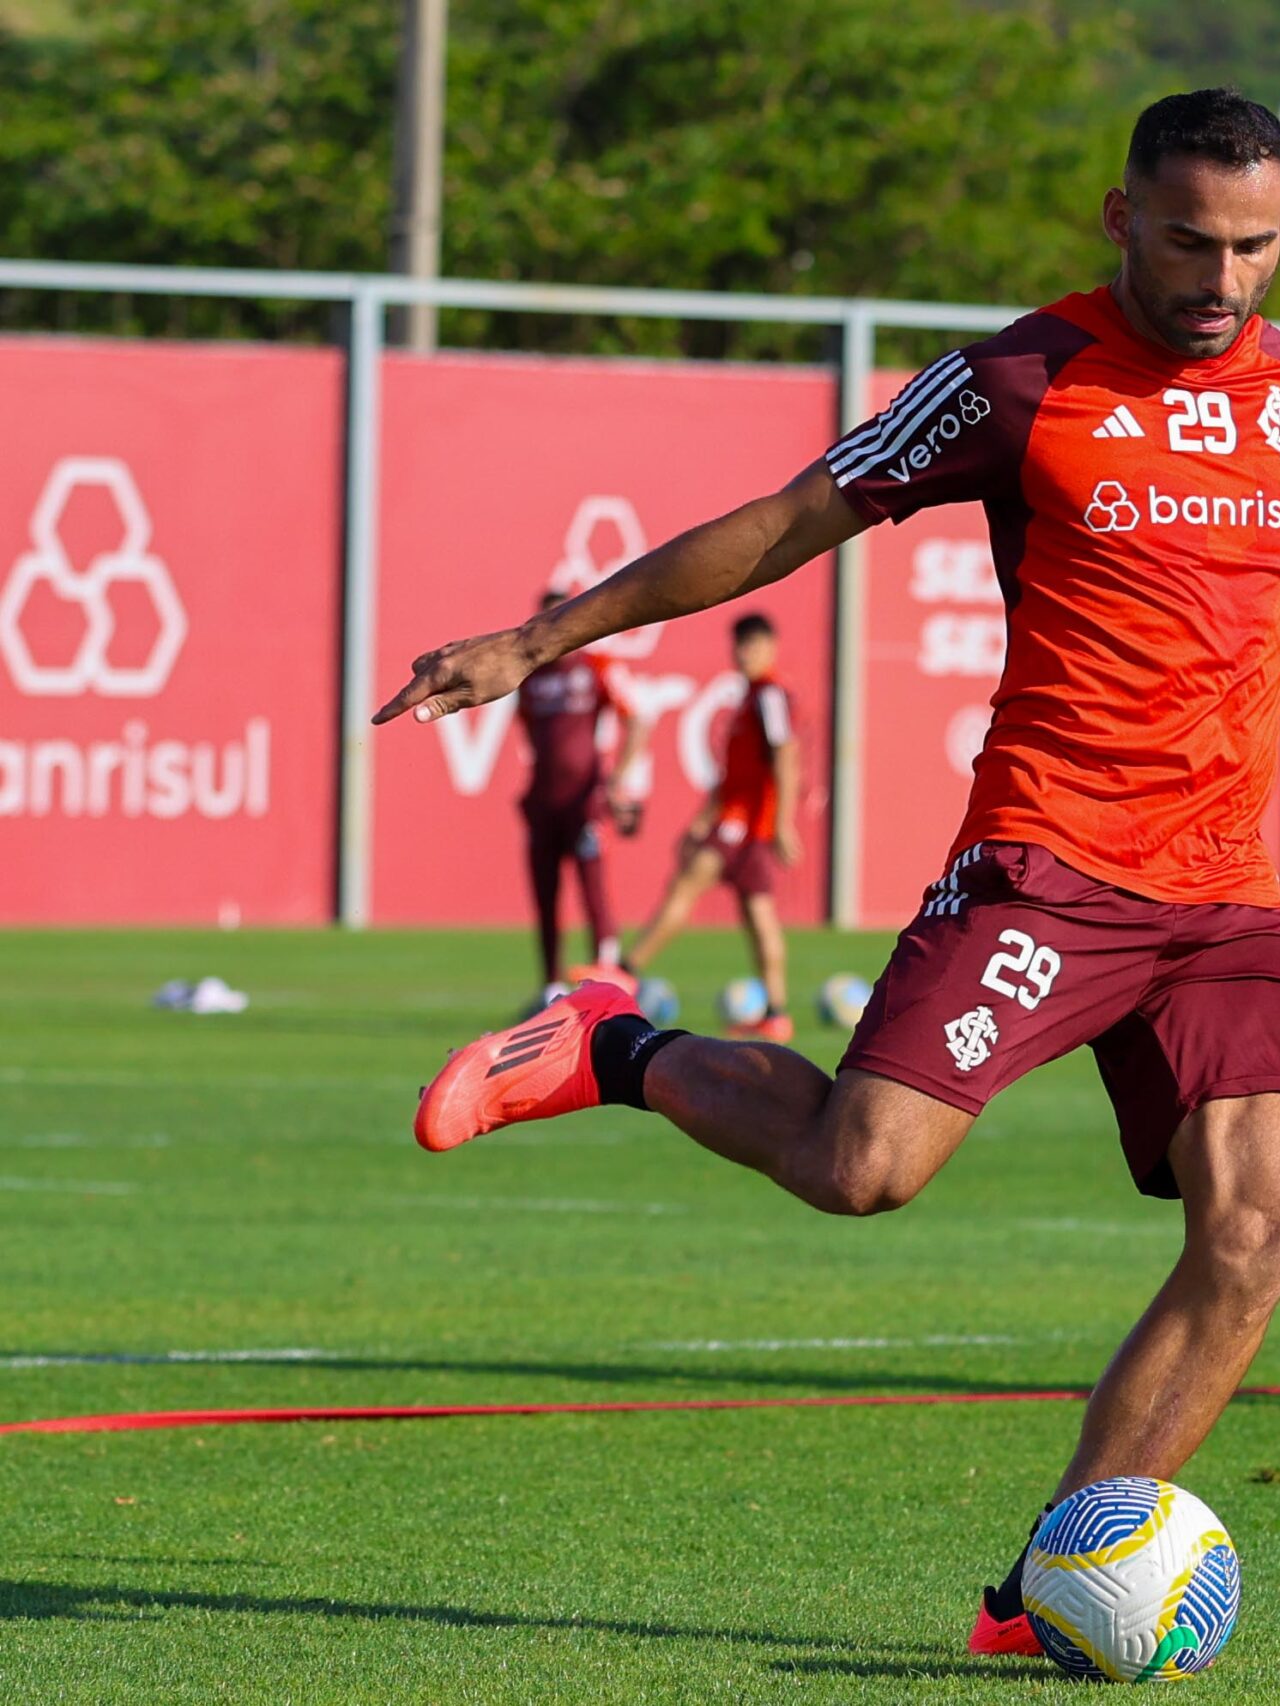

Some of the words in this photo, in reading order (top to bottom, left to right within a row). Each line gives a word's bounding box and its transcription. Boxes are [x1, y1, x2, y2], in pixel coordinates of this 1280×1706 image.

[887, 413, 961, 483] vero
[1163, 388, 1238, 455] 29
[979, 928, 1061, 1010] 29
